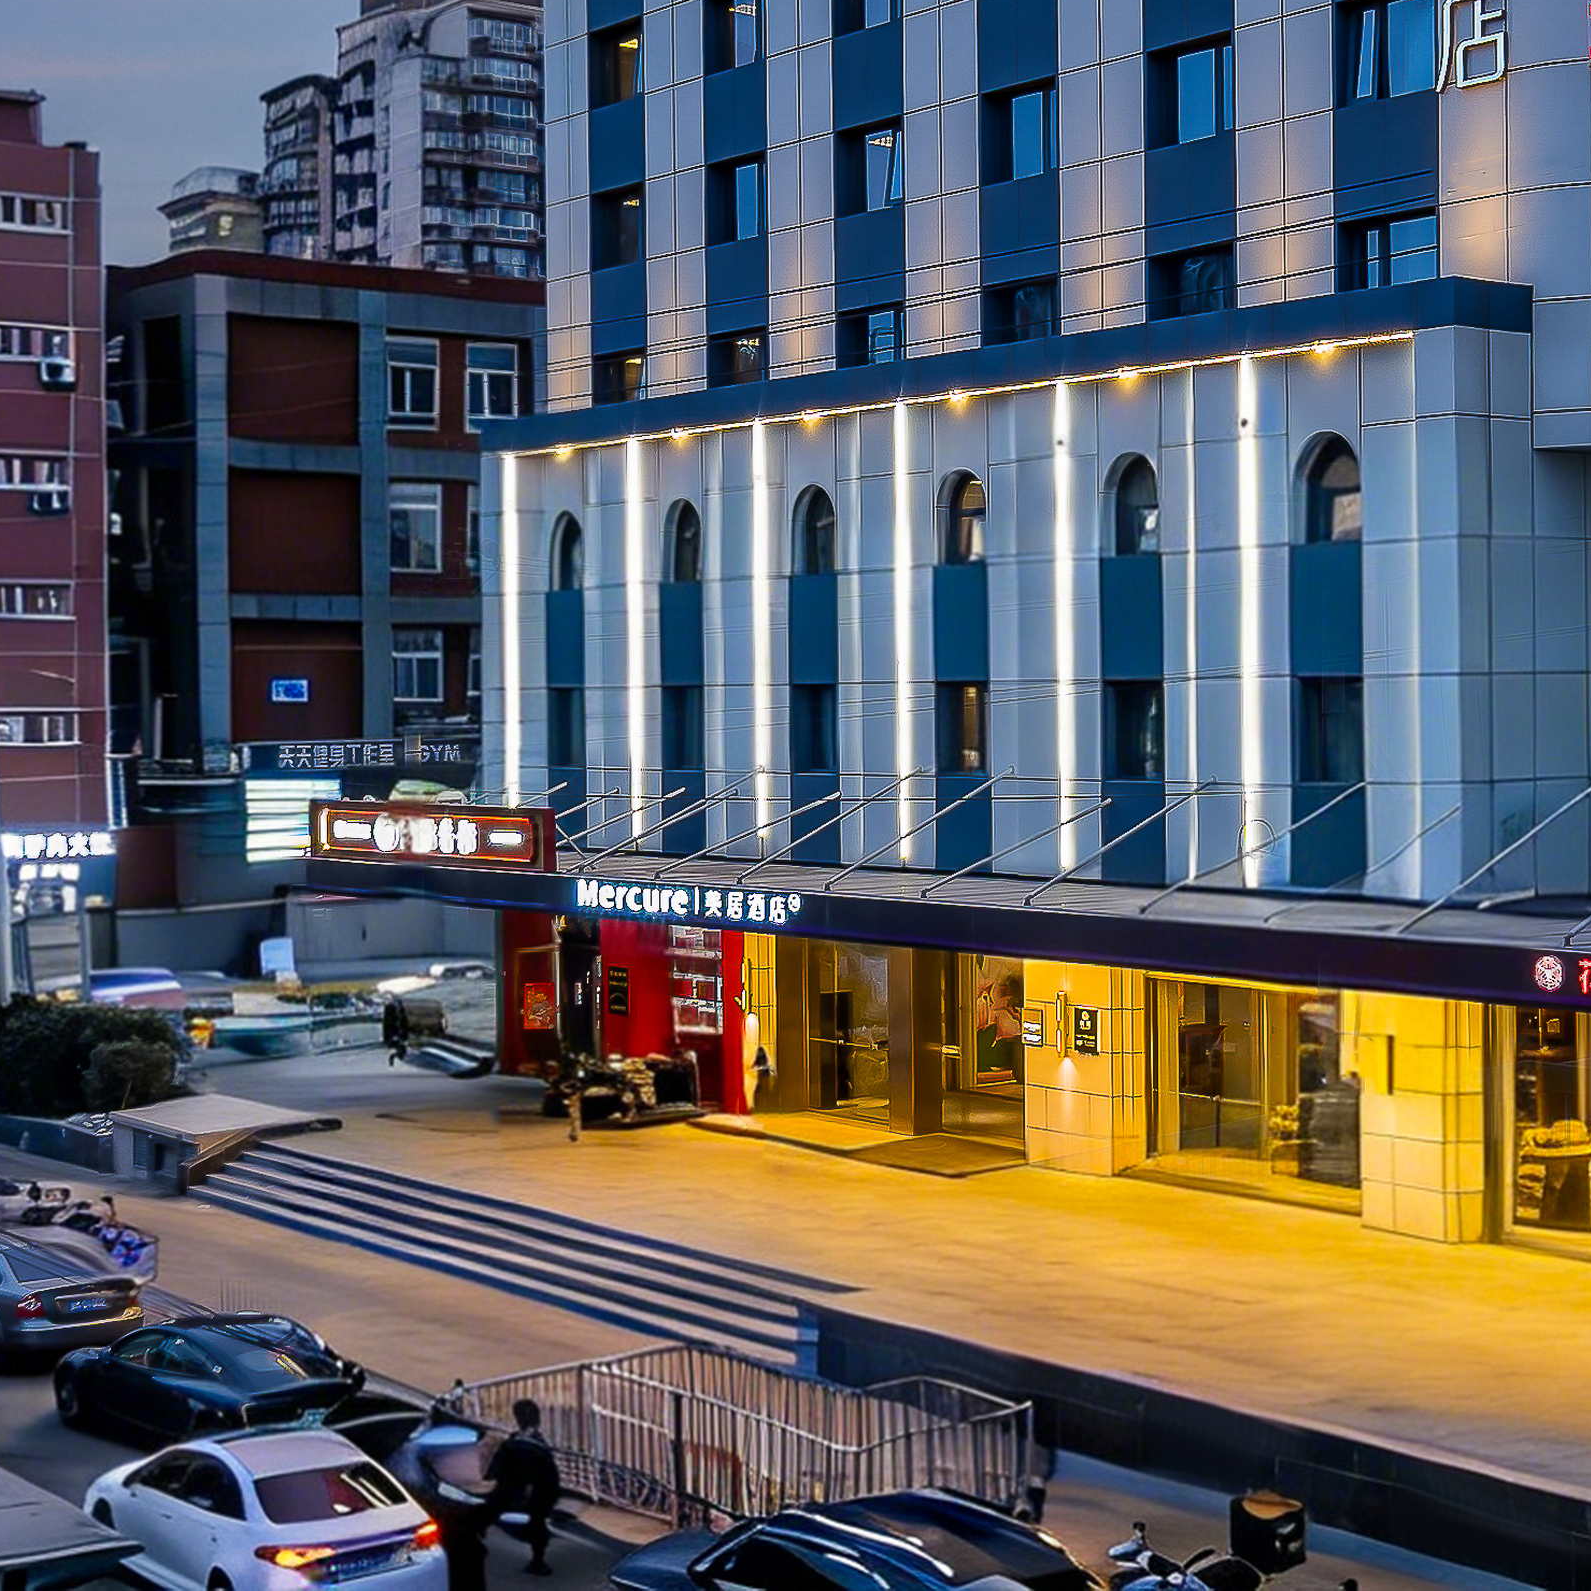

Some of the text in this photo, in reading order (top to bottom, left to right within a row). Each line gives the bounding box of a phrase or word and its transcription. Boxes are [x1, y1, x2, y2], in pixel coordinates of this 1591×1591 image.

[576, 877, 788, 925] Mercure 美居酒店
